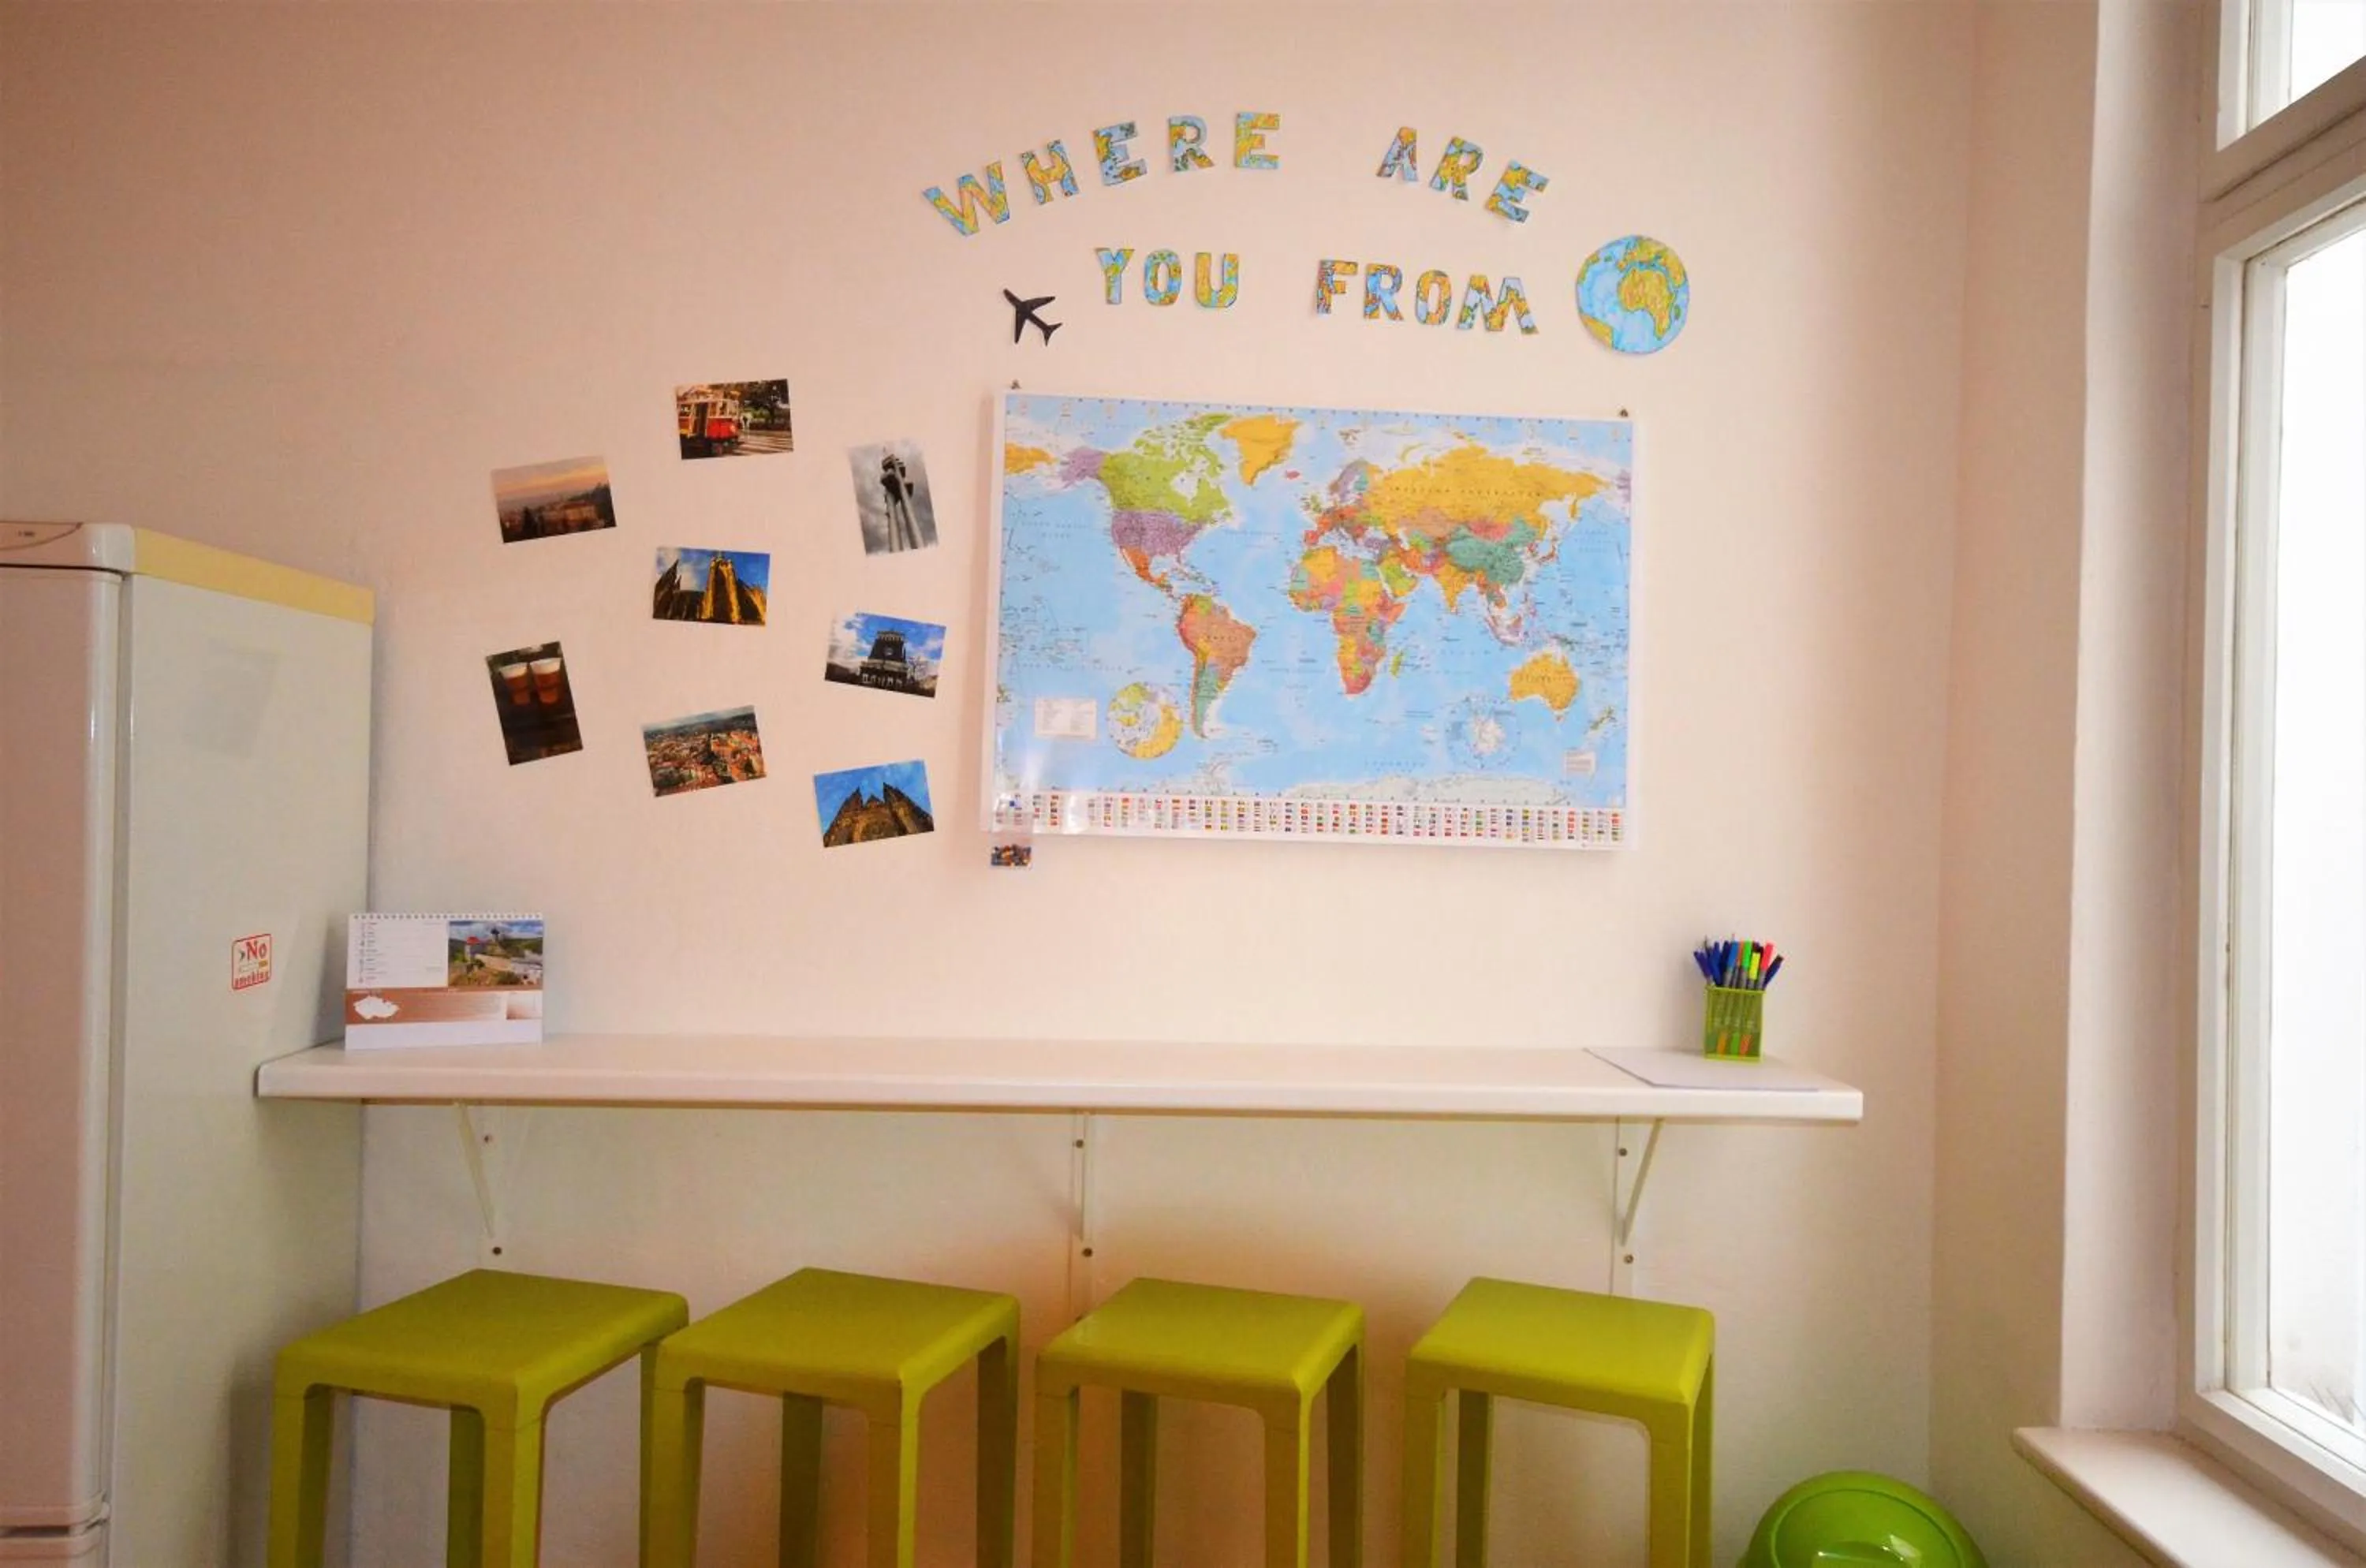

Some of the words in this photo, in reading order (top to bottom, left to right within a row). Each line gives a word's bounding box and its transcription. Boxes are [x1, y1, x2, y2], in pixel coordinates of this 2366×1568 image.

[922, 110, 1281, 237] WHERE
[1375, 125, 1551, 223] ARE
[1093, 247, 1241, 308] YOU
[1315, 259, 1540, 335] FROM
[245, 939, 268, 960] No
